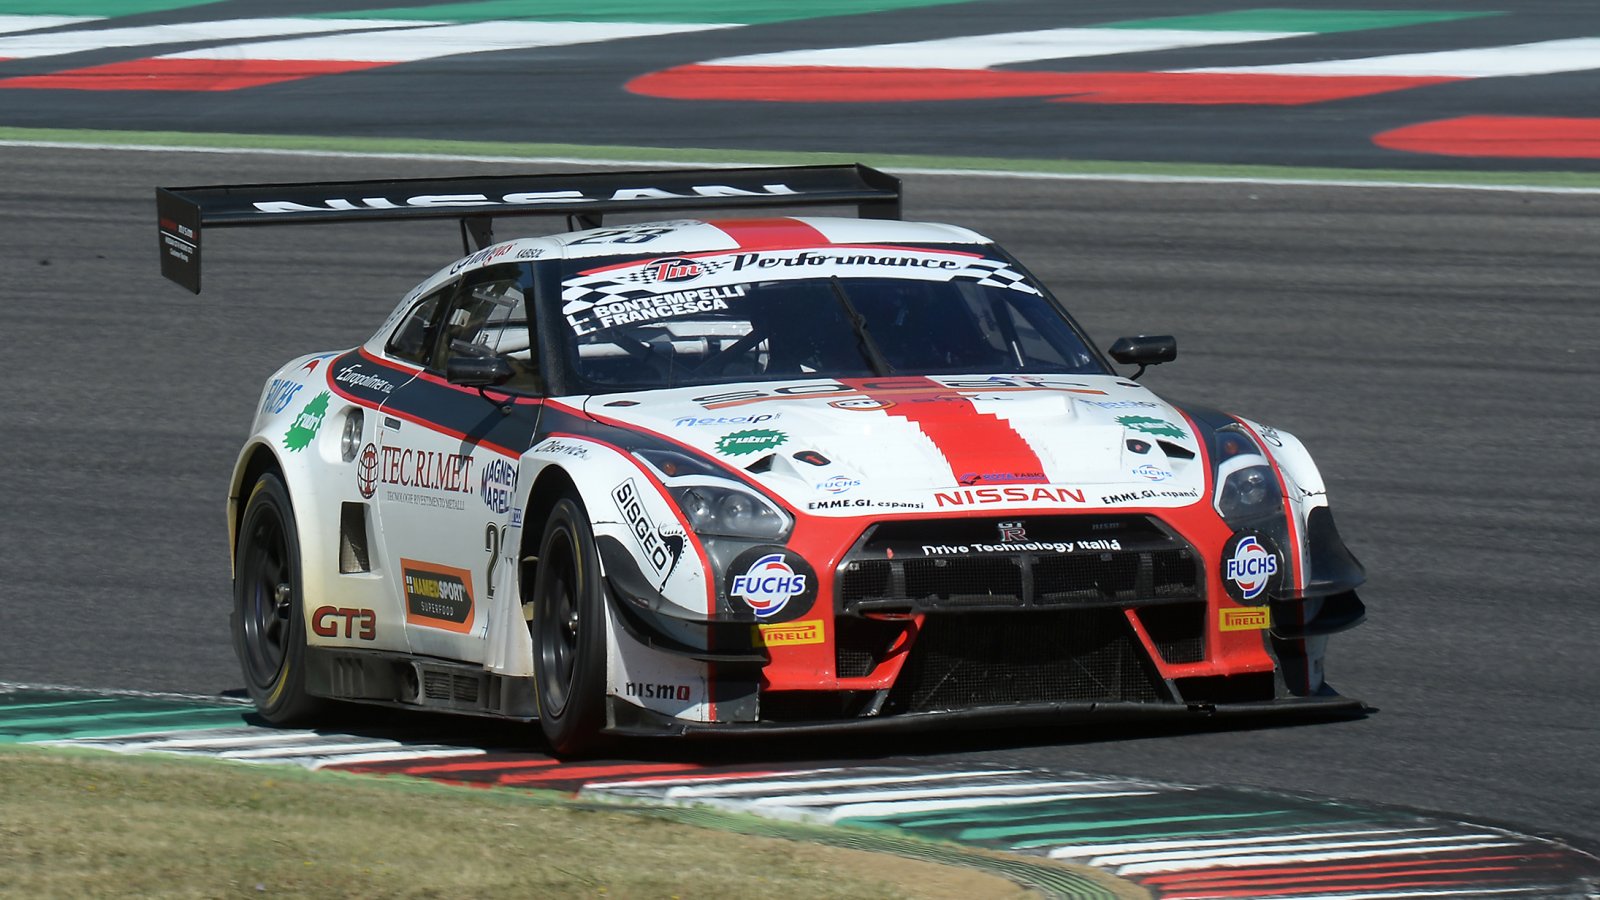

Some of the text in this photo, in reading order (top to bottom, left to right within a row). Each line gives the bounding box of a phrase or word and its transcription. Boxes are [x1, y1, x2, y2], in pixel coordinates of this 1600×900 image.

[730, 251, 961, 272] Performance
[566, 285, 746, 326] L. BONTEMPELLI
[573, 298, 729, 336] L. FRANCESCA
[380, 446, 474, 494] TEC.RI.MET.
[1132, 467, 1172, 478] FUCHS
[815, 479, 861, 490] FUCHS
[808, 499, 924, 510] EMME.GI. espansi
[934, 488, 1086, 507] NISSAN
[616, 483, 667, 570] SISGEO
[921, 545, 969, 556] Drive
[971, 541, 1074, 553] Technology
[1228, 555, 1276, 578] FUCHS
[732, 576, 805, 595] FUCHS
[420, 601, 454, 616] SUPERFOOD
[312, 605, 377, 641] GT3
[1224, 611, 1265, 626] PIRELLI
[625, 682, 690, 701] nismo
